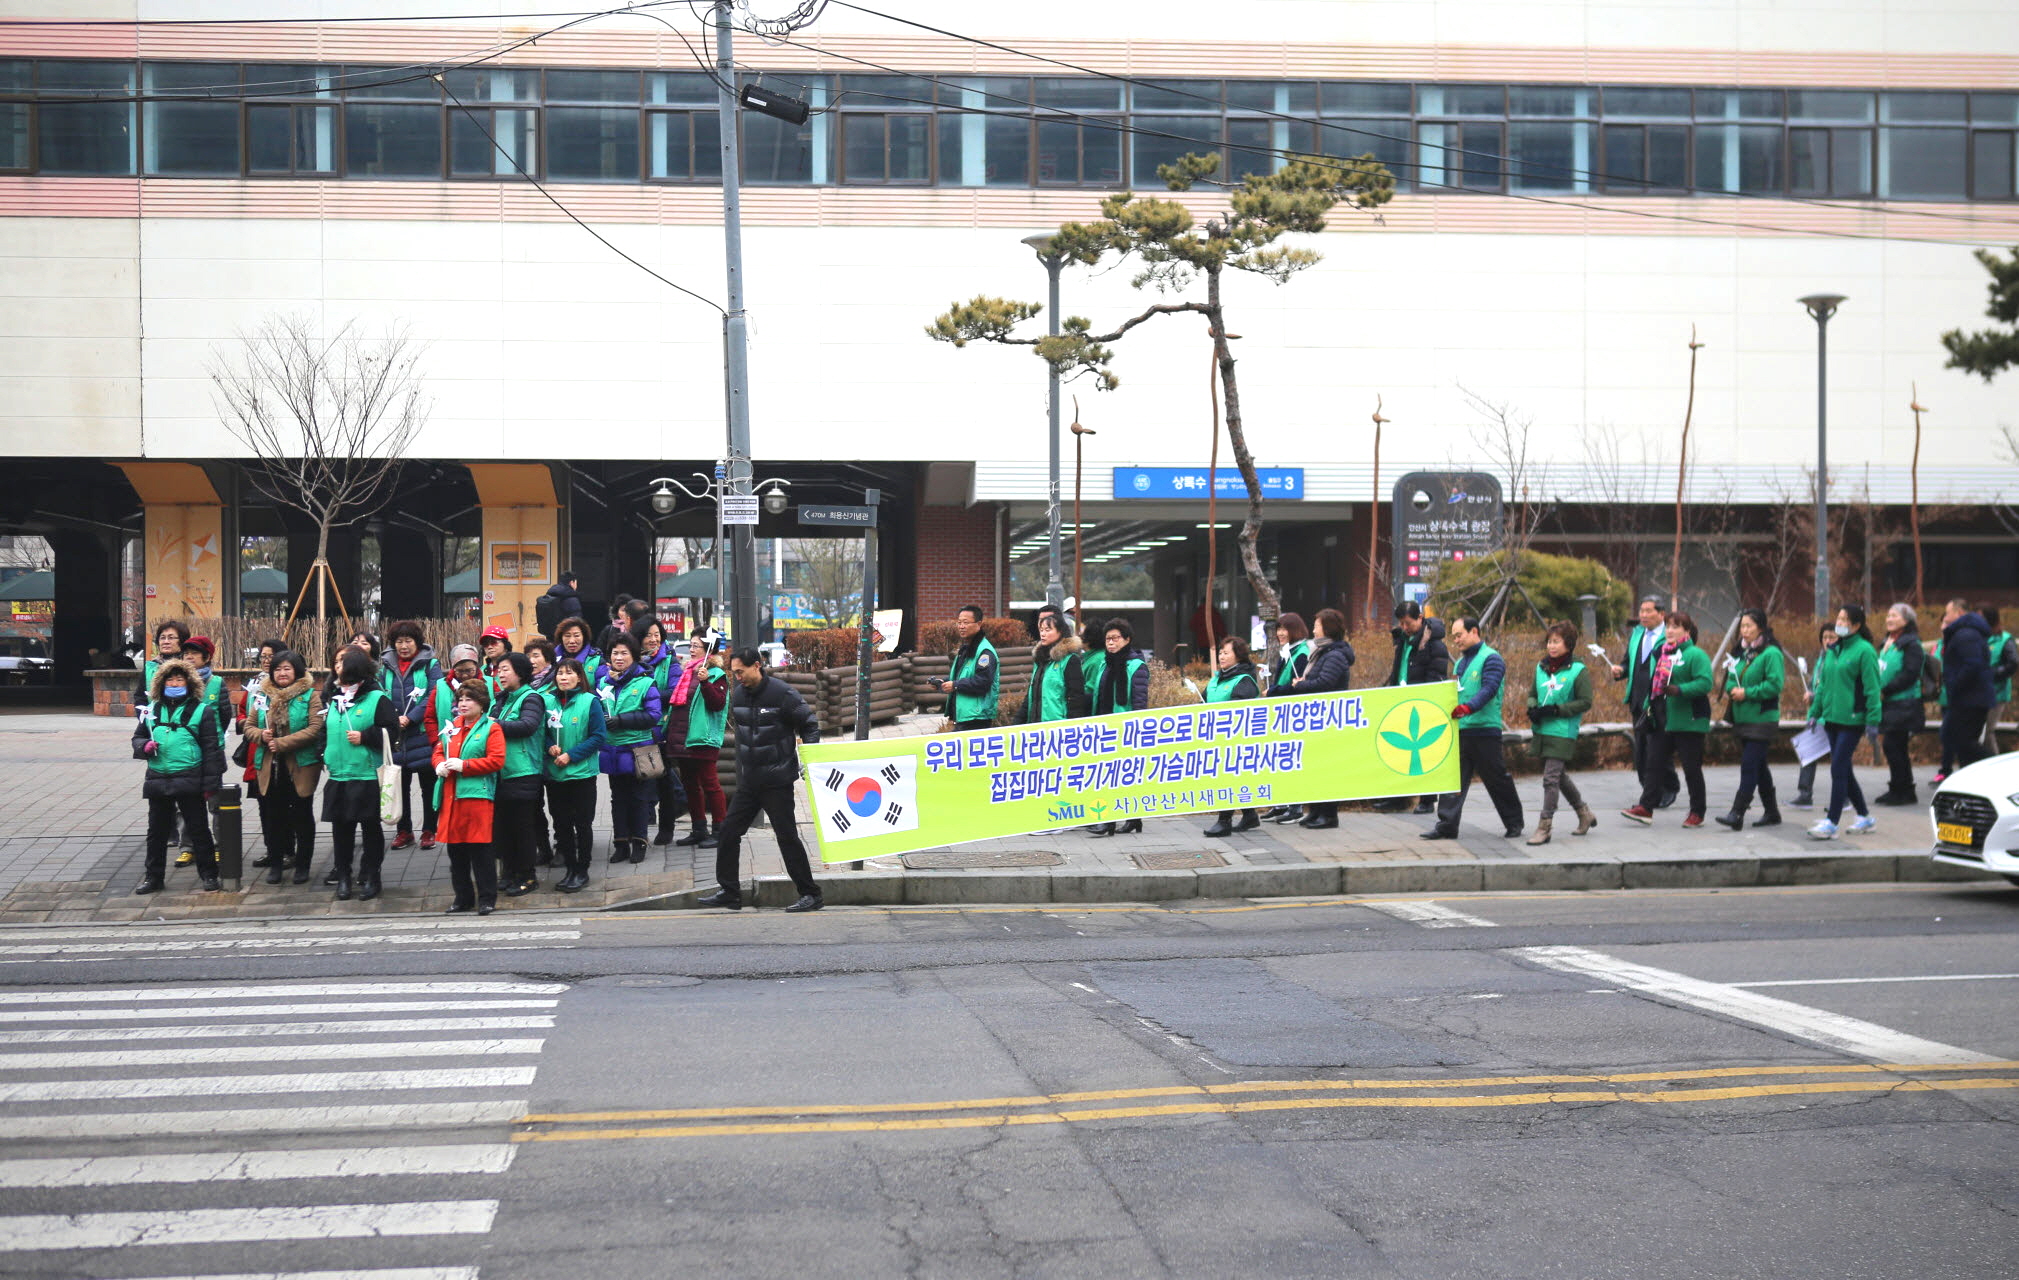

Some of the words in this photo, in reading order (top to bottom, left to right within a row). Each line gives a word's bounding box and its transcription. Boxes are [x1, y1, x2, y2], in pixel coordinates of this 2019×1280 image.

[1172, 475, 1207, 490] 상록수
[1284, 476, 1295, 491] 3
[926, 739, 962, 772] 우리
[968, 735, 1004, 768] 모두
[1010, 723, 1117, 763] 나라사랑하는
[1123, 714, 1193, 748] 마음으로
[1197, 706, 1268, 741] 태극기를
[1272, 697, 1368, 734] 게양합시다.
[991, 766, 1062, 802] 집집마다
[1067, 756, 1145, 792] 국기게양!
[1148, 747, 1220, 783] 가슴마다
[1224, 741, 1303, 775] 나라사랑!
